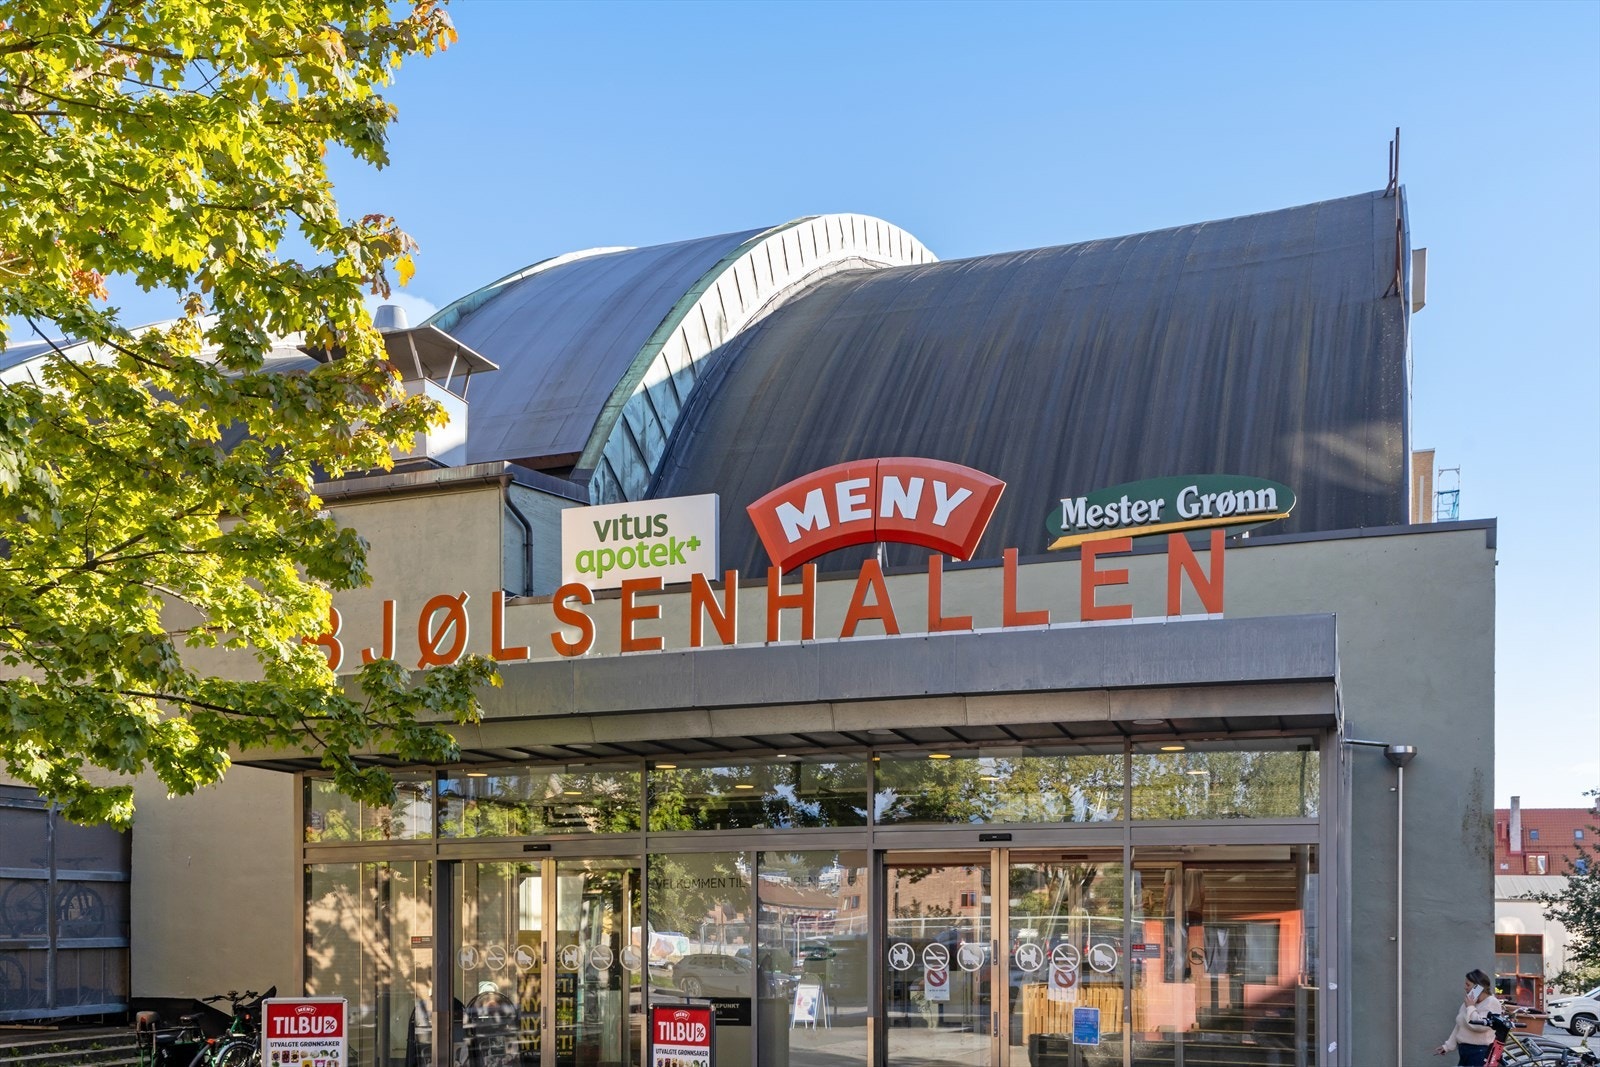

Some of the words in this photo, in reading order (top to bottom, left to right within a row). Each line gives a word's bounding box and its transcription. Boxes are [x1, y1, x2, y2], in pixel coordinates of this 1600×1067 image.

[775, 476, 973, 543] MENY
[1060, 495, 1164, 530] Mester
[1176, 485, 1279, 519] Grønn
[593, 513, 668, 542] vitus
[655, 877, 726, 889] VELKOMMEN
[729, 877, 746, 888] TIL
[678, 1049, 708, 1057] GRØNNSAKER
